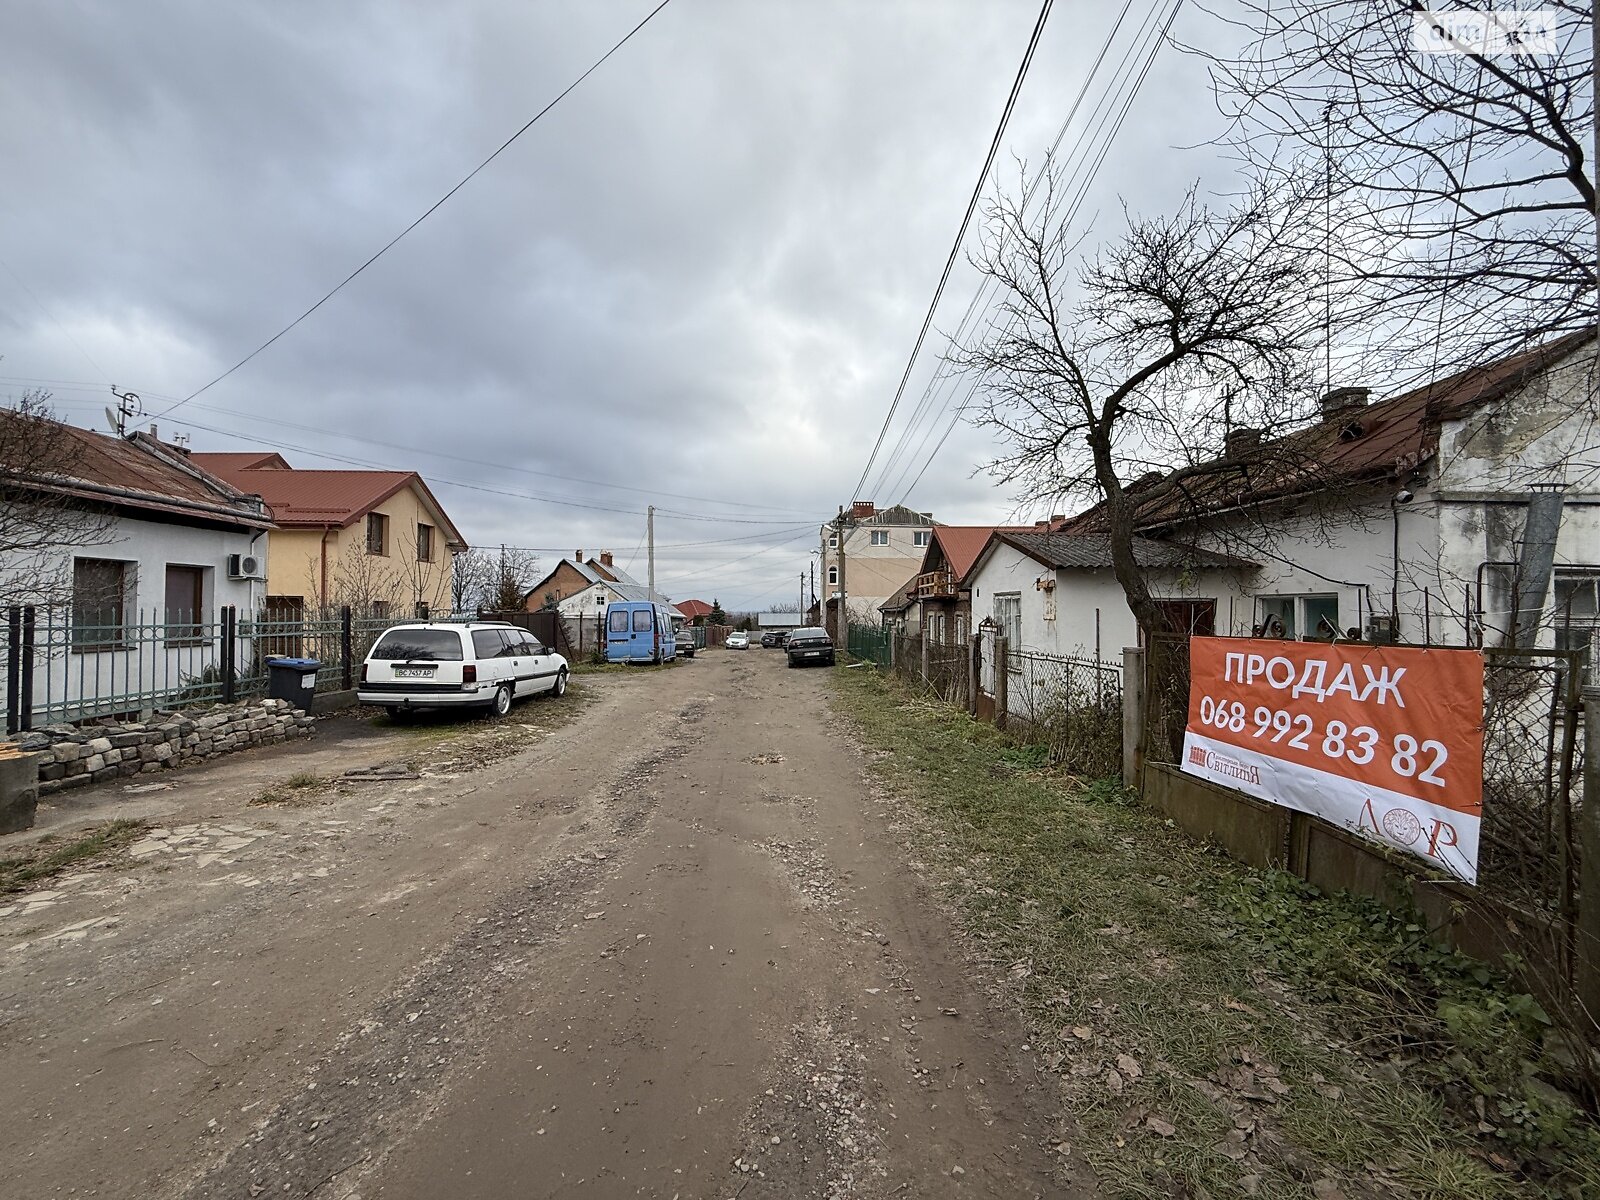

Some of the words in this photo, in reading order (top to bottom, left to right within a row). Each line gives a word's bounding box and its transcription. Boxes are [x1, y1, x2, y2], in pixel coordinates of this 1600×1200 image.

[1224, 652, 1407, 708] ПРОДАЖ
[1200, 695, 1246, 733] 068
[1252, 706, 1313, 751] 992
[1322, 720, 1379, 765] 83
[1390, 733, 1448, 787] 82
